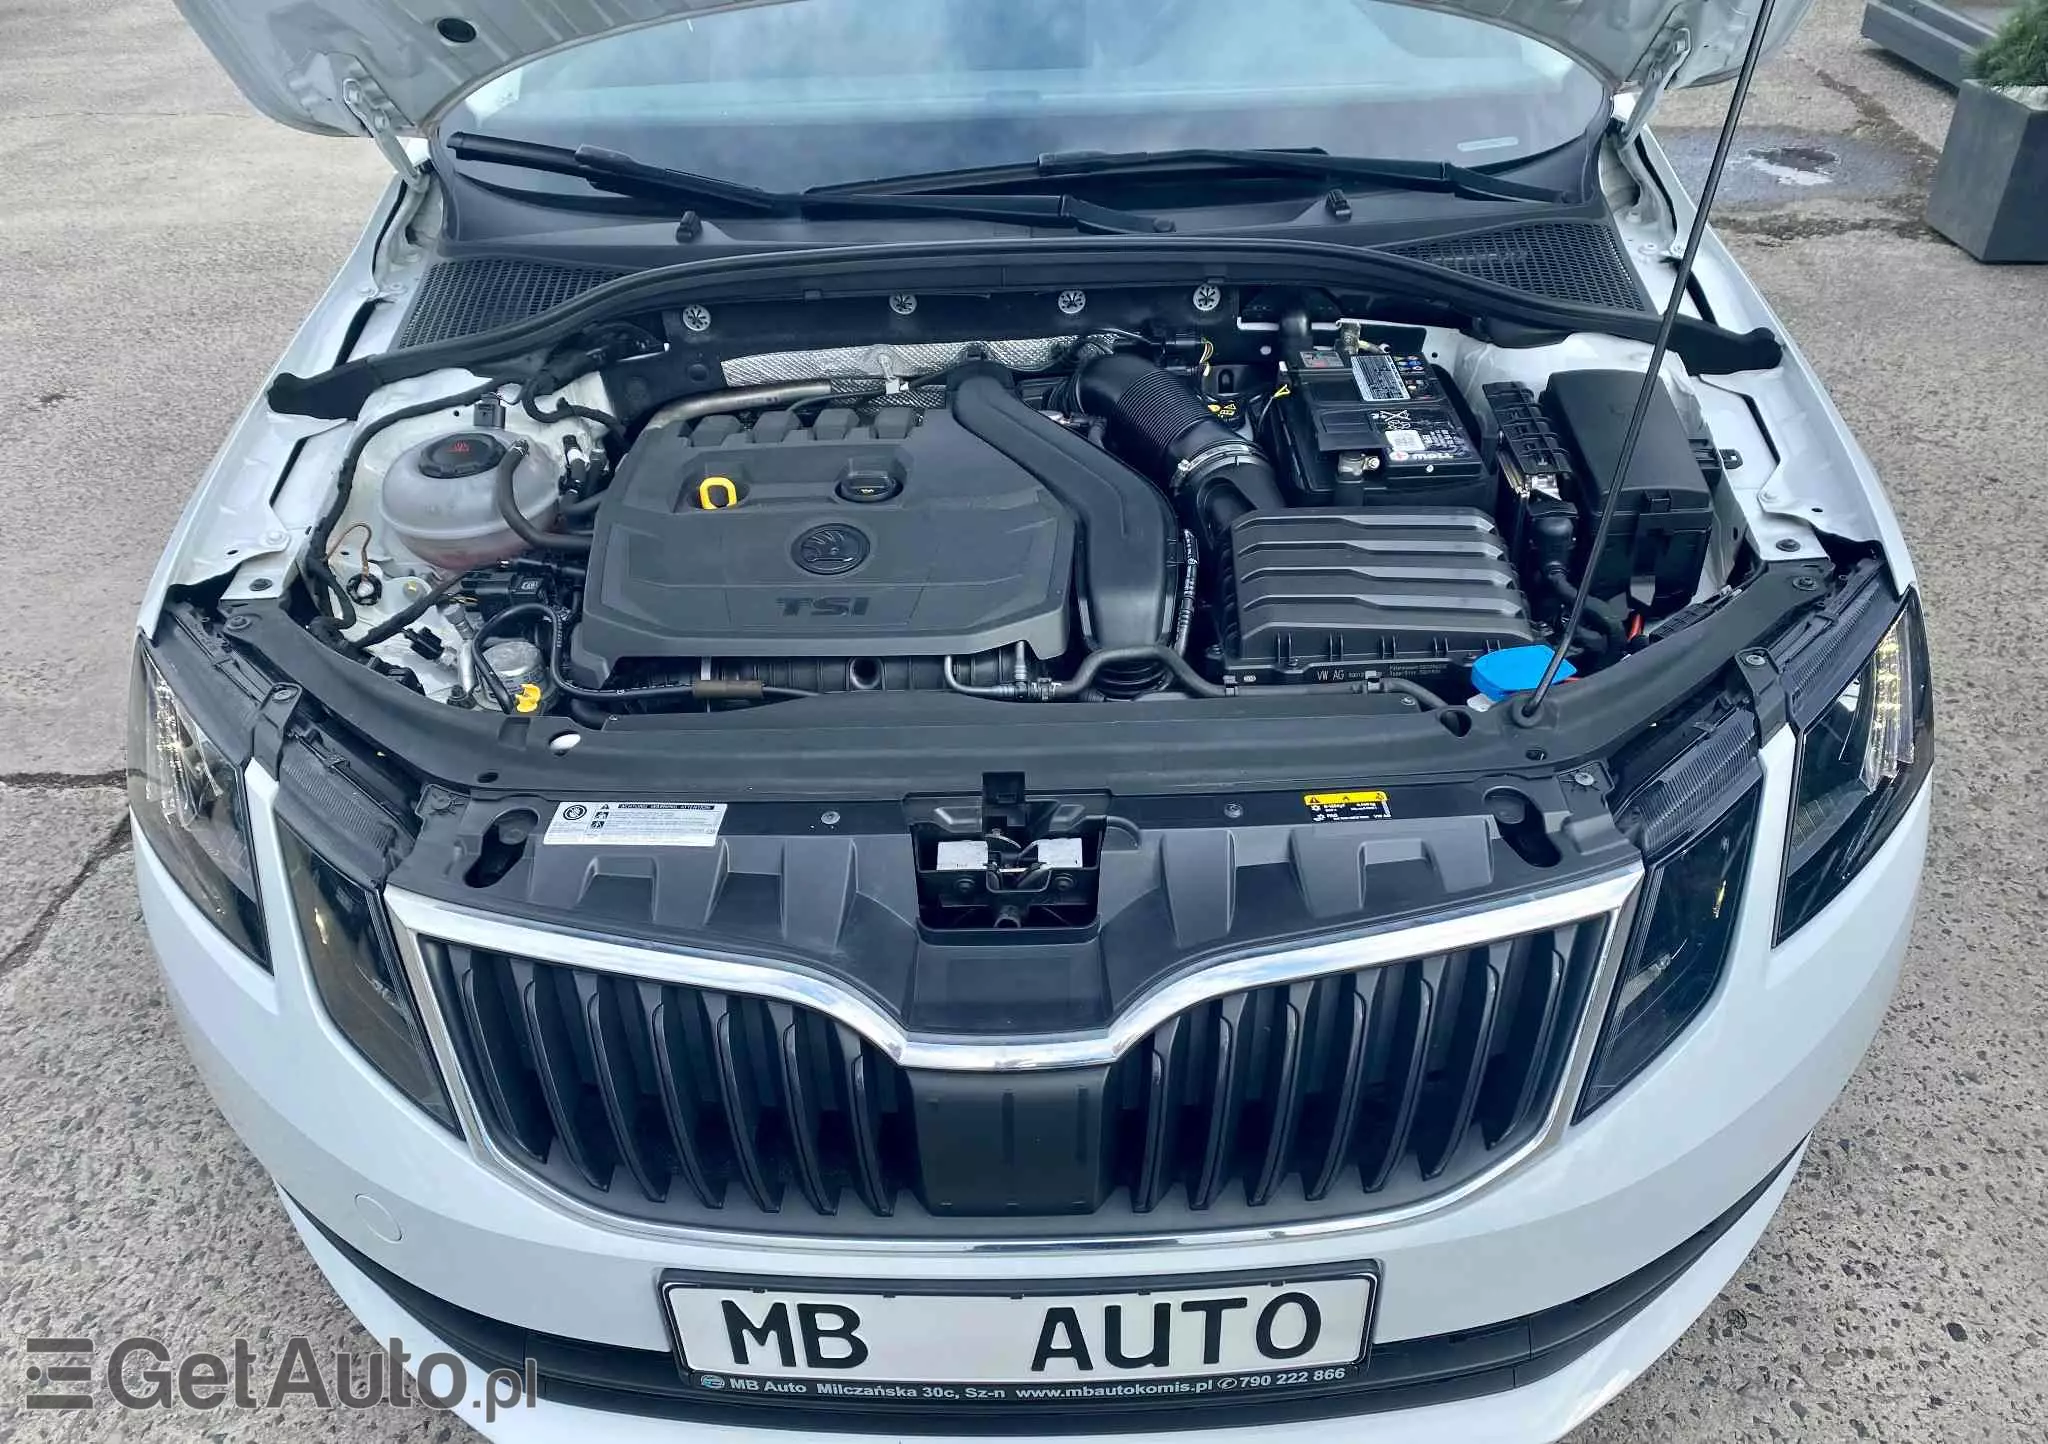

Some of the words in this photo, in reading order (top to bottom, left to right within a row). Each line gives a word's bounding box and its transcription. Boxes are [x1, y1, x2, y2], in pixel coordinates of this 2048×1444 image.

[775, 597, 870, 616] TSI
[1317, 670, 1329, 681] VW
[1333, 669, 1345, 681] AG
[721, 1300, 869, 1368] MB
[1031, 1292, 1321, 1371] AUTO
[730, 1378, 759, 1391] MB
[764, 1381, 807, 1394] Auto
[816, 1383, 917, 1397] Milczańska
[923, 1387, 960, 1400] 30c,
[965, 1387, 1006, 1399] Sz-n
[1016, 1379, 1213, 1399] www.mbautokomis.pl
[1239, 1374, 1272, 1388] 790
[1276, 1371, 1308, 1385] 222
[1313, 1367, 1346, 1381] 866
